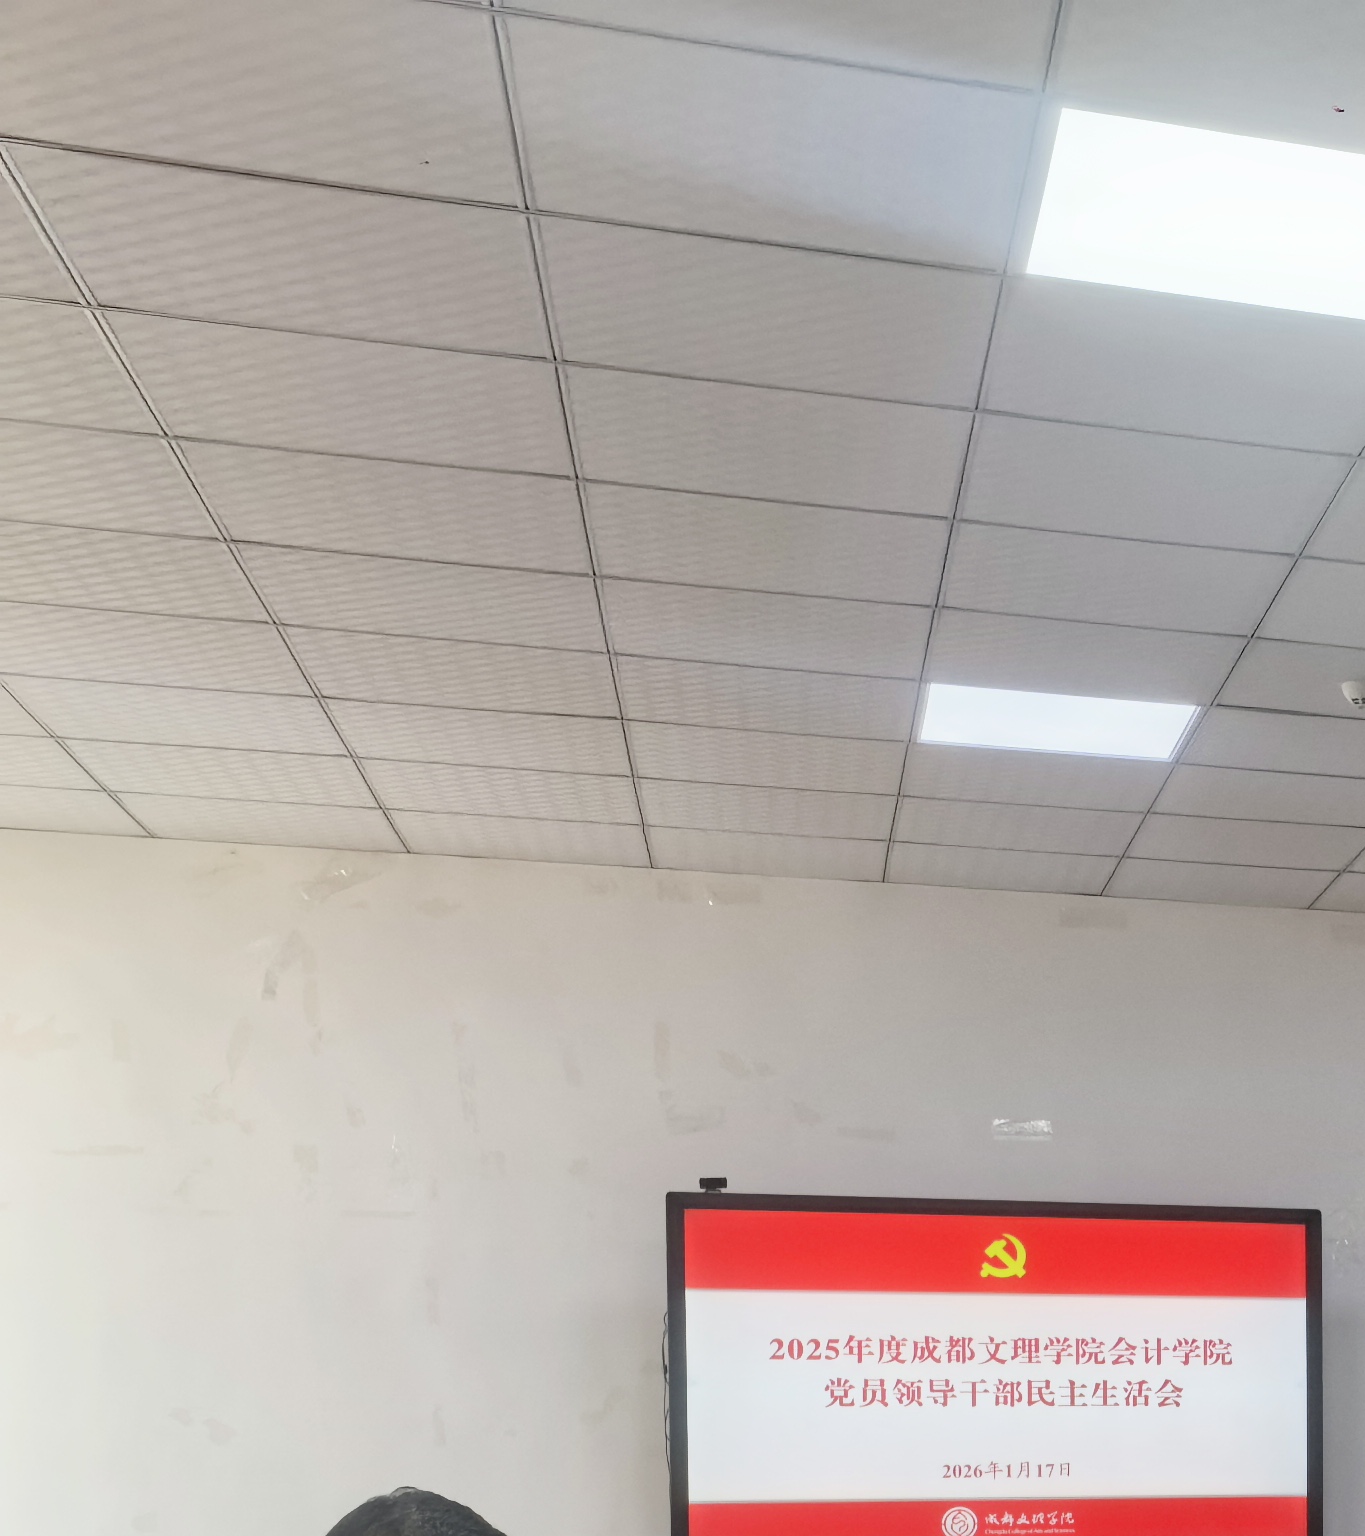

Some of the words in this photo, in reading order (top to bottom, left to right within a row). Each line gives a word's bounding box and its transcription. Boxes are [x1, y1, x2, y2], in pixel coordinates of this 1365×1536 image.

[769, 1335, 1234, 1366] 2025年度成都文理学院会计学院
[824, 1378, 1184, 1408] 党员领导干部民主生活会
[942, 1460, 1071, 1480] 2026年1月17日
